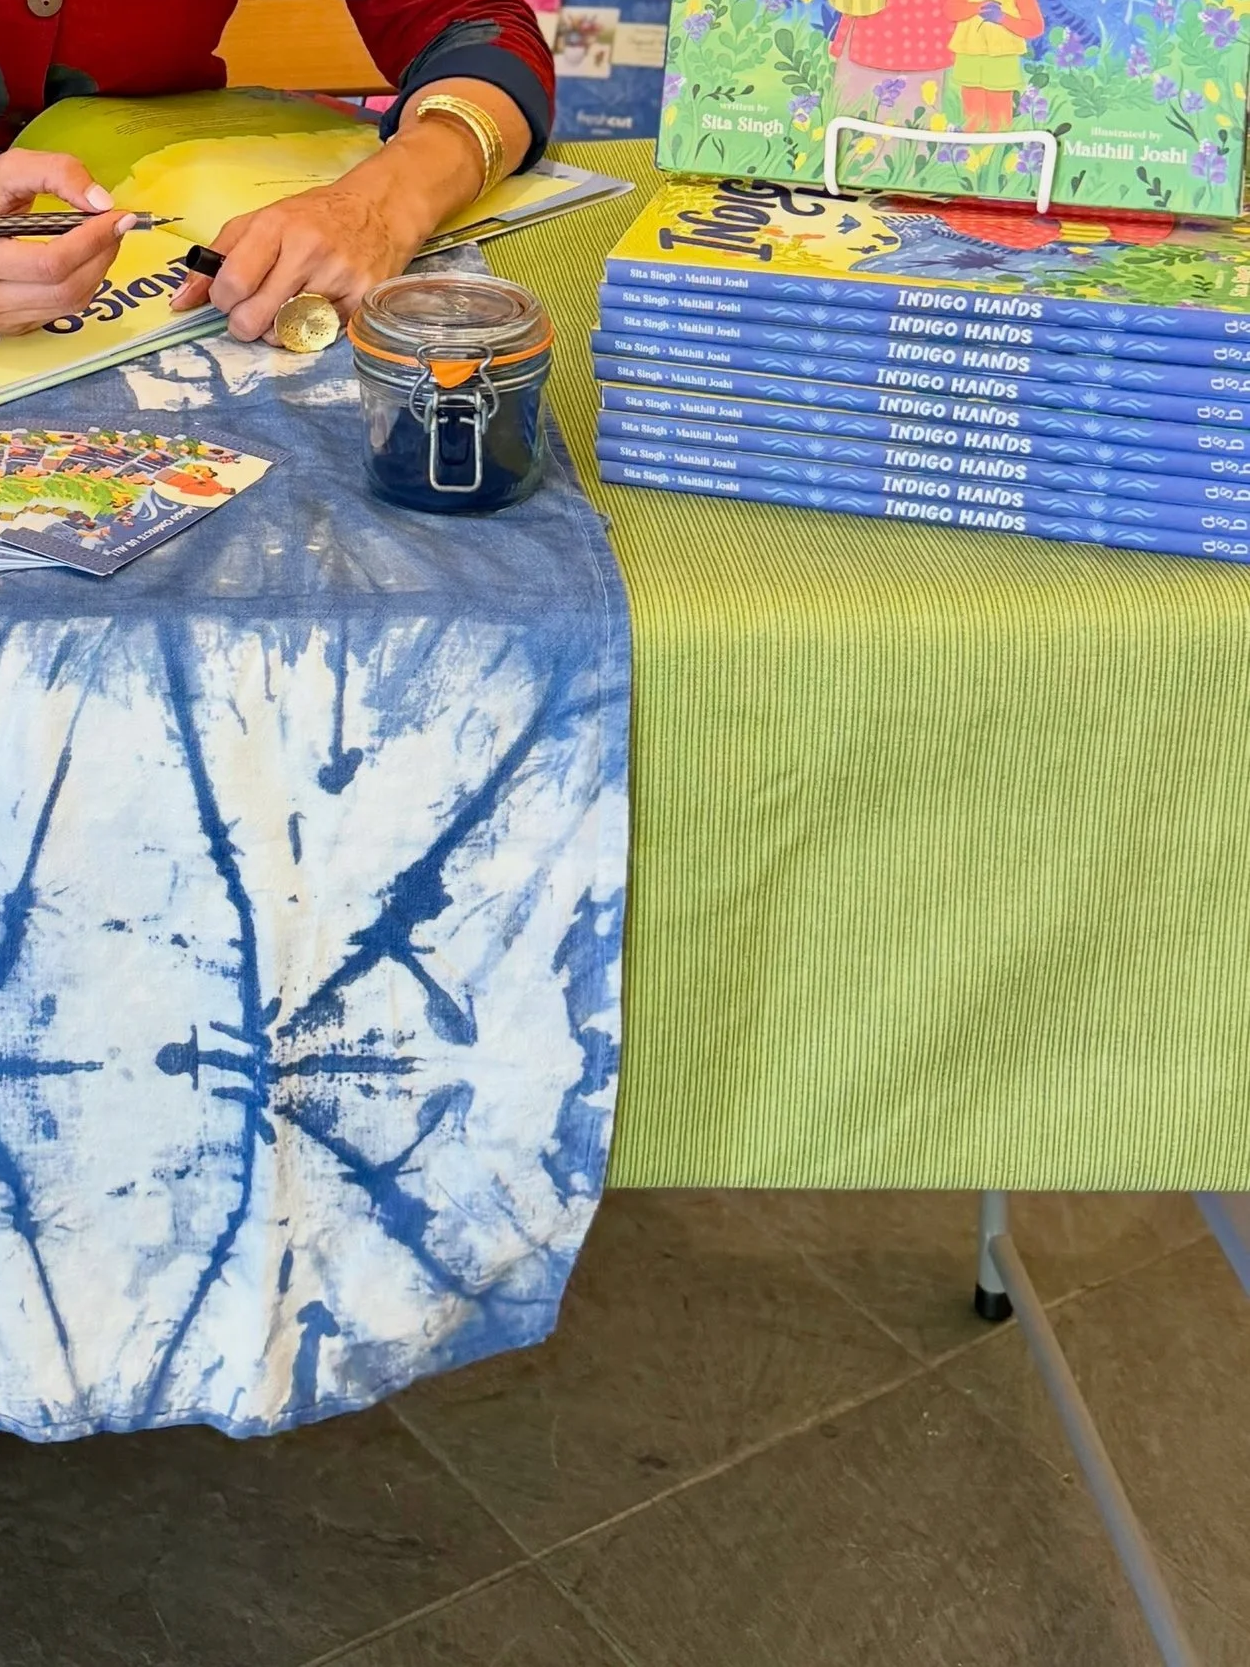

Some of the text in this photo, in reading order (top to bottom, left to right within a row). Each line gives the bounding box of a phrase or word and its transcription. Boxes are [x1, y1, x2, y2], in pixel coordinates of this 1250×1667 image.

[701, 114, 784, 136] Sita Singh
[1063, 140, 1187, 164] Maithili Joshi
[42, 256, 189, 334] NDIGO
[898, 290, 1043, 319] INDIGO HANDS
[889, 316, 1033, 345] INDIGO HANDS
[887, 342, 1031, 373] INDIGO HANDS
[876, 368, 1019, 399] INDIGO HANDS
[878, 395, 1020, 427] INDIGO HANDS
[889, 423, 1032, 454] INDIGO HANDS
[884, 449, 1027, 481] INDIGO HANDS
[882, 476, 1025, 508] INDIGO HANDS
[884, 499, 1026, 532] INDIGO HANDS
